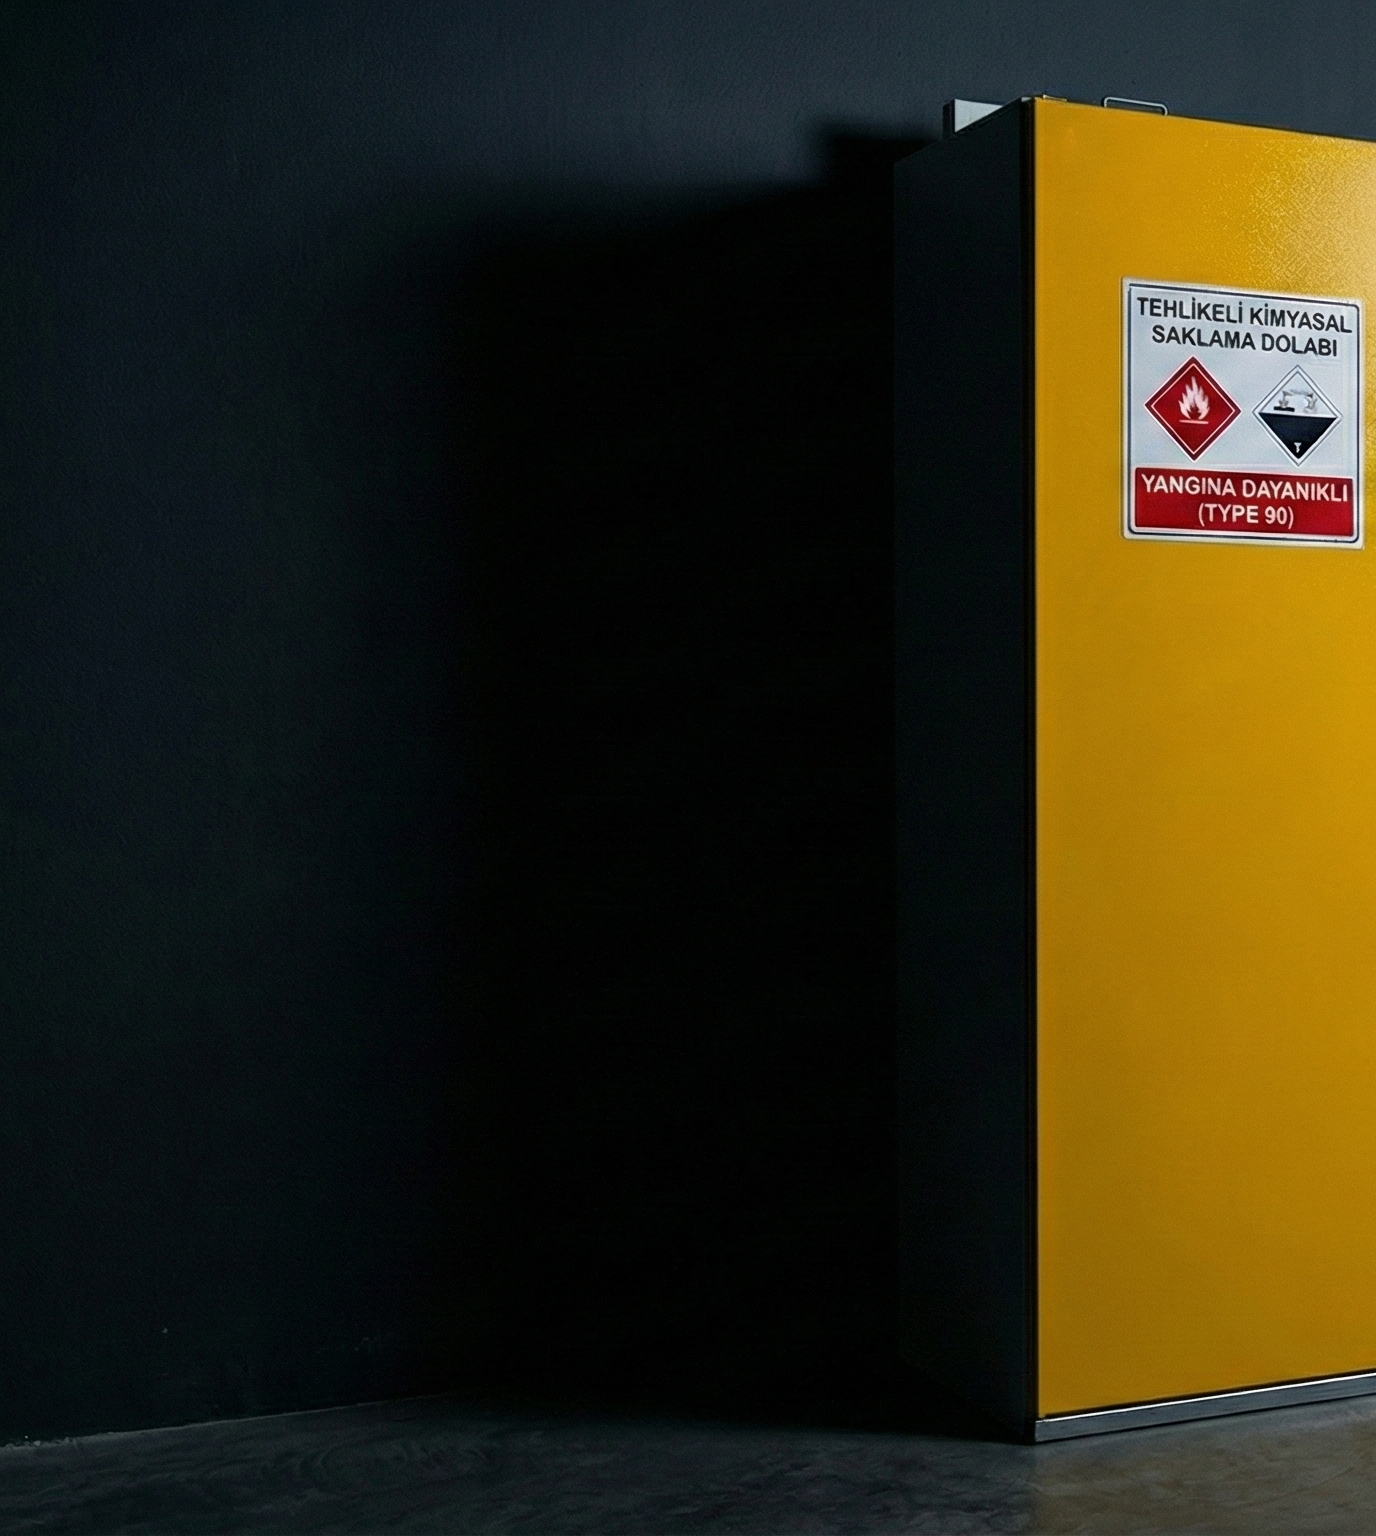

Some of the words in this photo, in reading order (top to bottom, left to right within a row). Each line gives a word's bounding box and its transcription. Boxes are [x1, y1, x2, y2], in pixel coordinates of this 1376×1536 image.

[1137, 297, 1243, 324] TEHLİKELİ
[1250, 303, 1353, 334] KİMYASAL
[1152, 325, 1256, 350] SAKLAMA
[1261, 333, 1337, 357] DOLABI
[1141, 473, 1237, 497] YANGINA
[1242, 479, 1348, 502] DAYANIKLI
[1198, 503, 1259, 527] (TYPE
[1265, 505, 1294, 530] 90)
